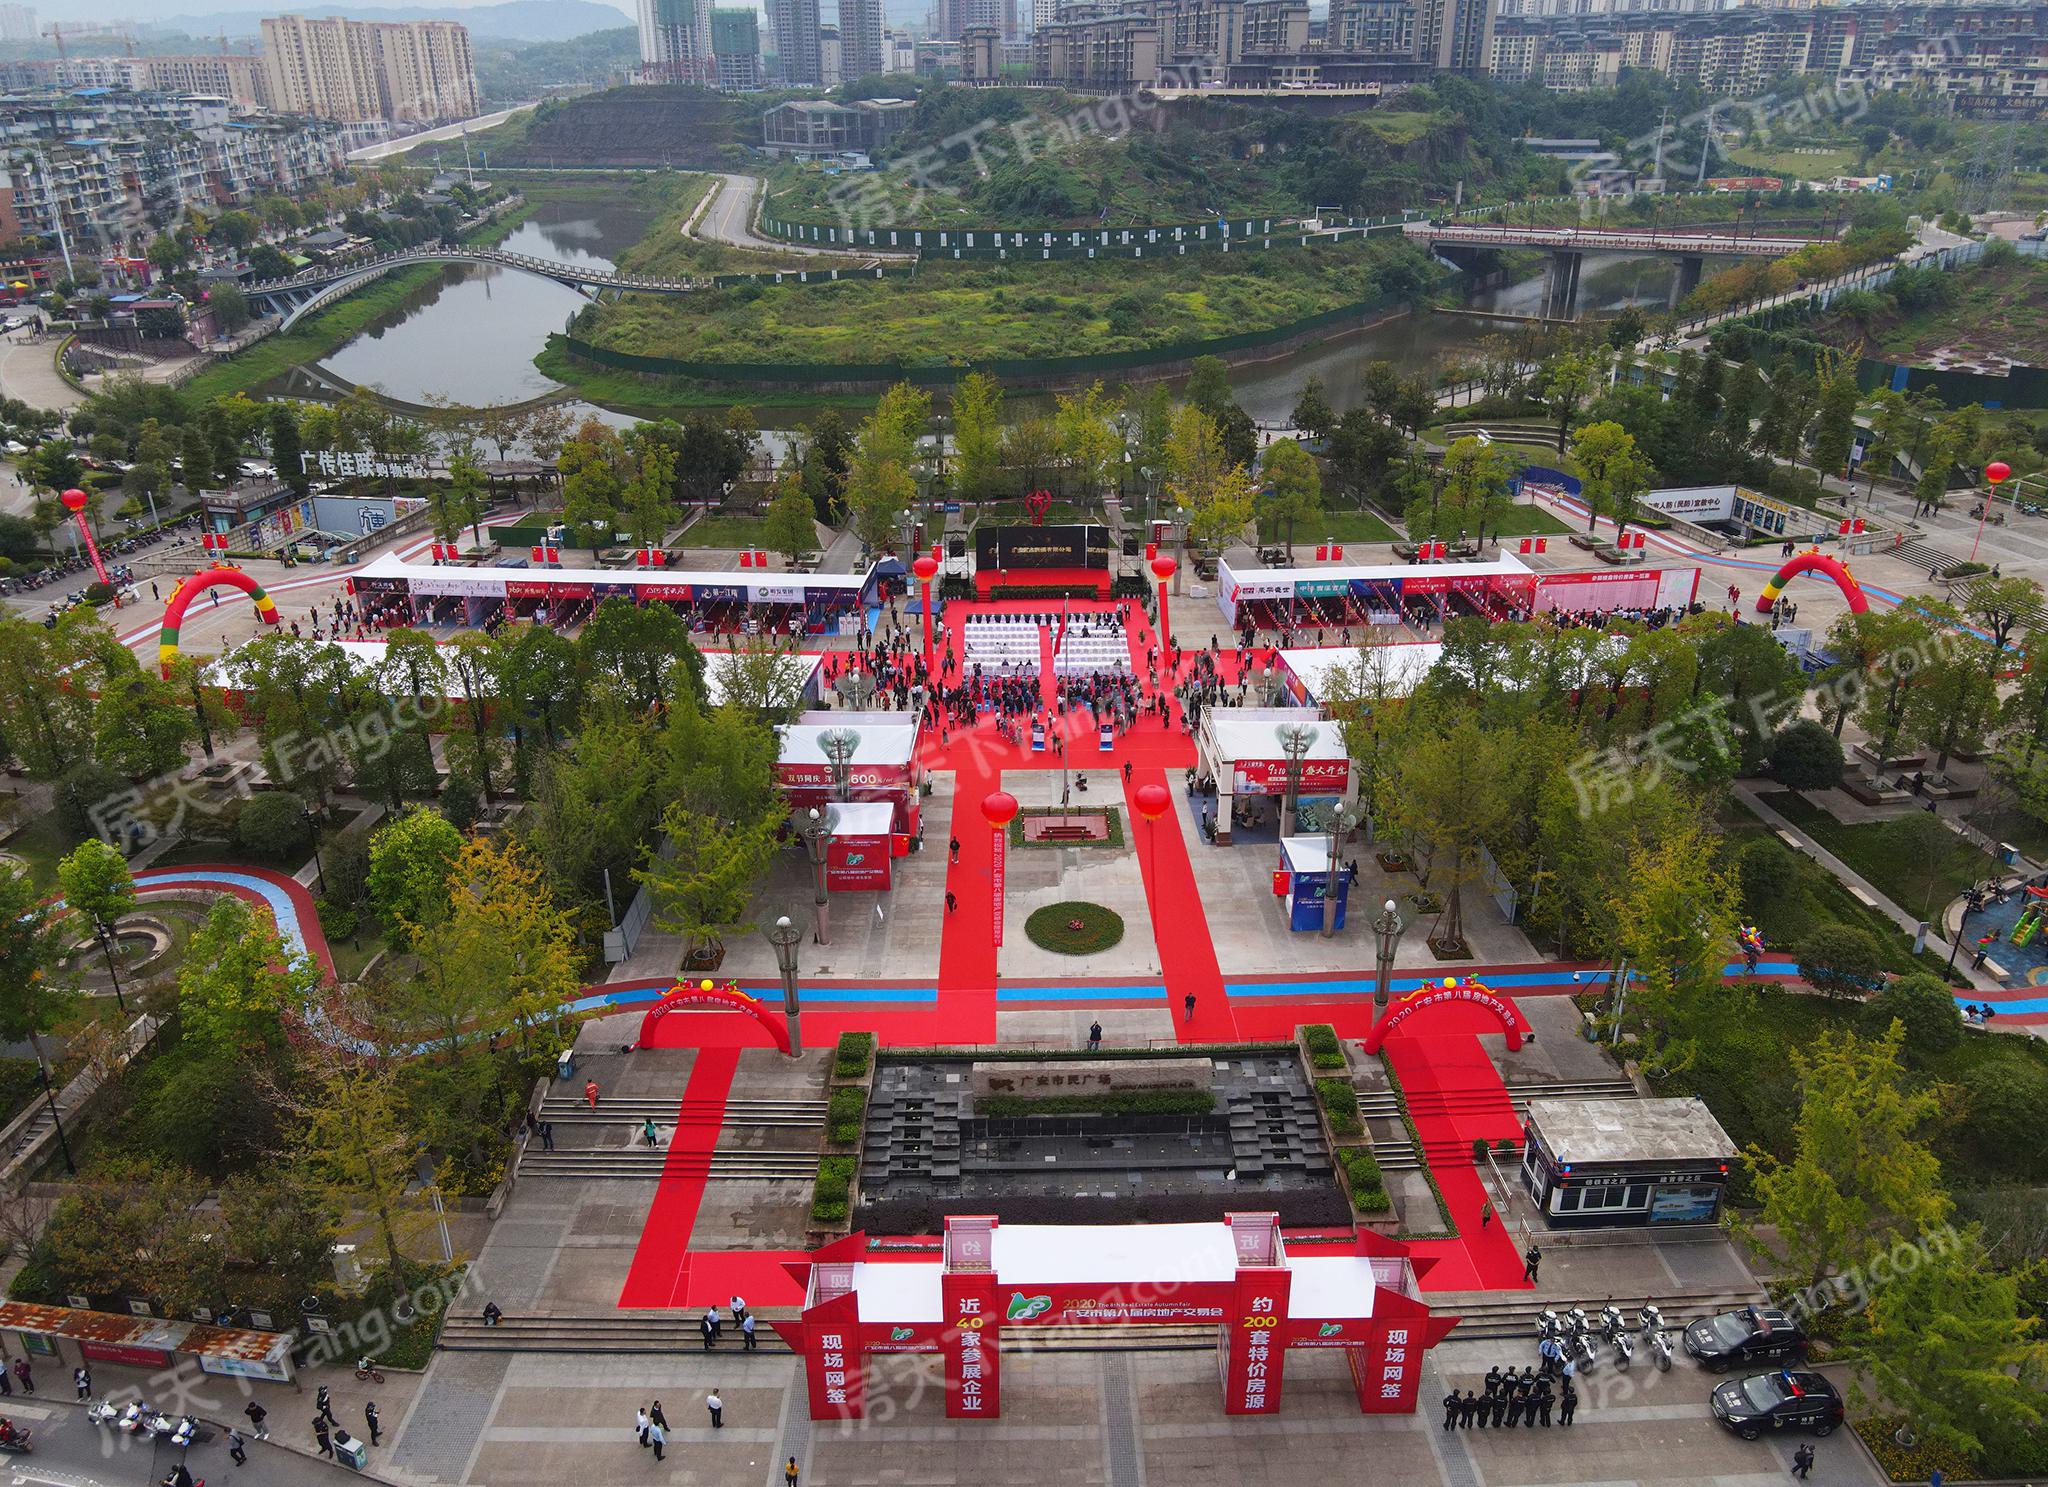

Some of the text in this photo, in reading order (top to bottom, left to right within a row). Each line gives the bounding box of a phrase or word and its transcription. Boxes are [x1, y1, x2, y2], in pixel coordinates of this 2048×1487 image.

[300, 450, 375, 477] 广传佳联
[375, 462, 428, 478] 购物中心
[787, 774, 821, 783] 双节同庆
[651, 995, 759, 1019] 2020 广安市第八届房地产交易会
[1388, 990, 1516, 1028] 2020 广安市第八届房地产交易会
[1020, 1074, 1112, 1087] 广安市民广场
[1062, 1308, 1224, 1318] 广安市第八届房地产交易会
[1063, 1299, 1097, 1309] 2020
[956, 1298, 984, 1411] 近40家参展企业
[1243, 1297, 1278, 1409] 约200套特价房源
[1381, 1329, 1408, 1399] 现场网签
[821, 1334, 847, 1405] 现场网签
